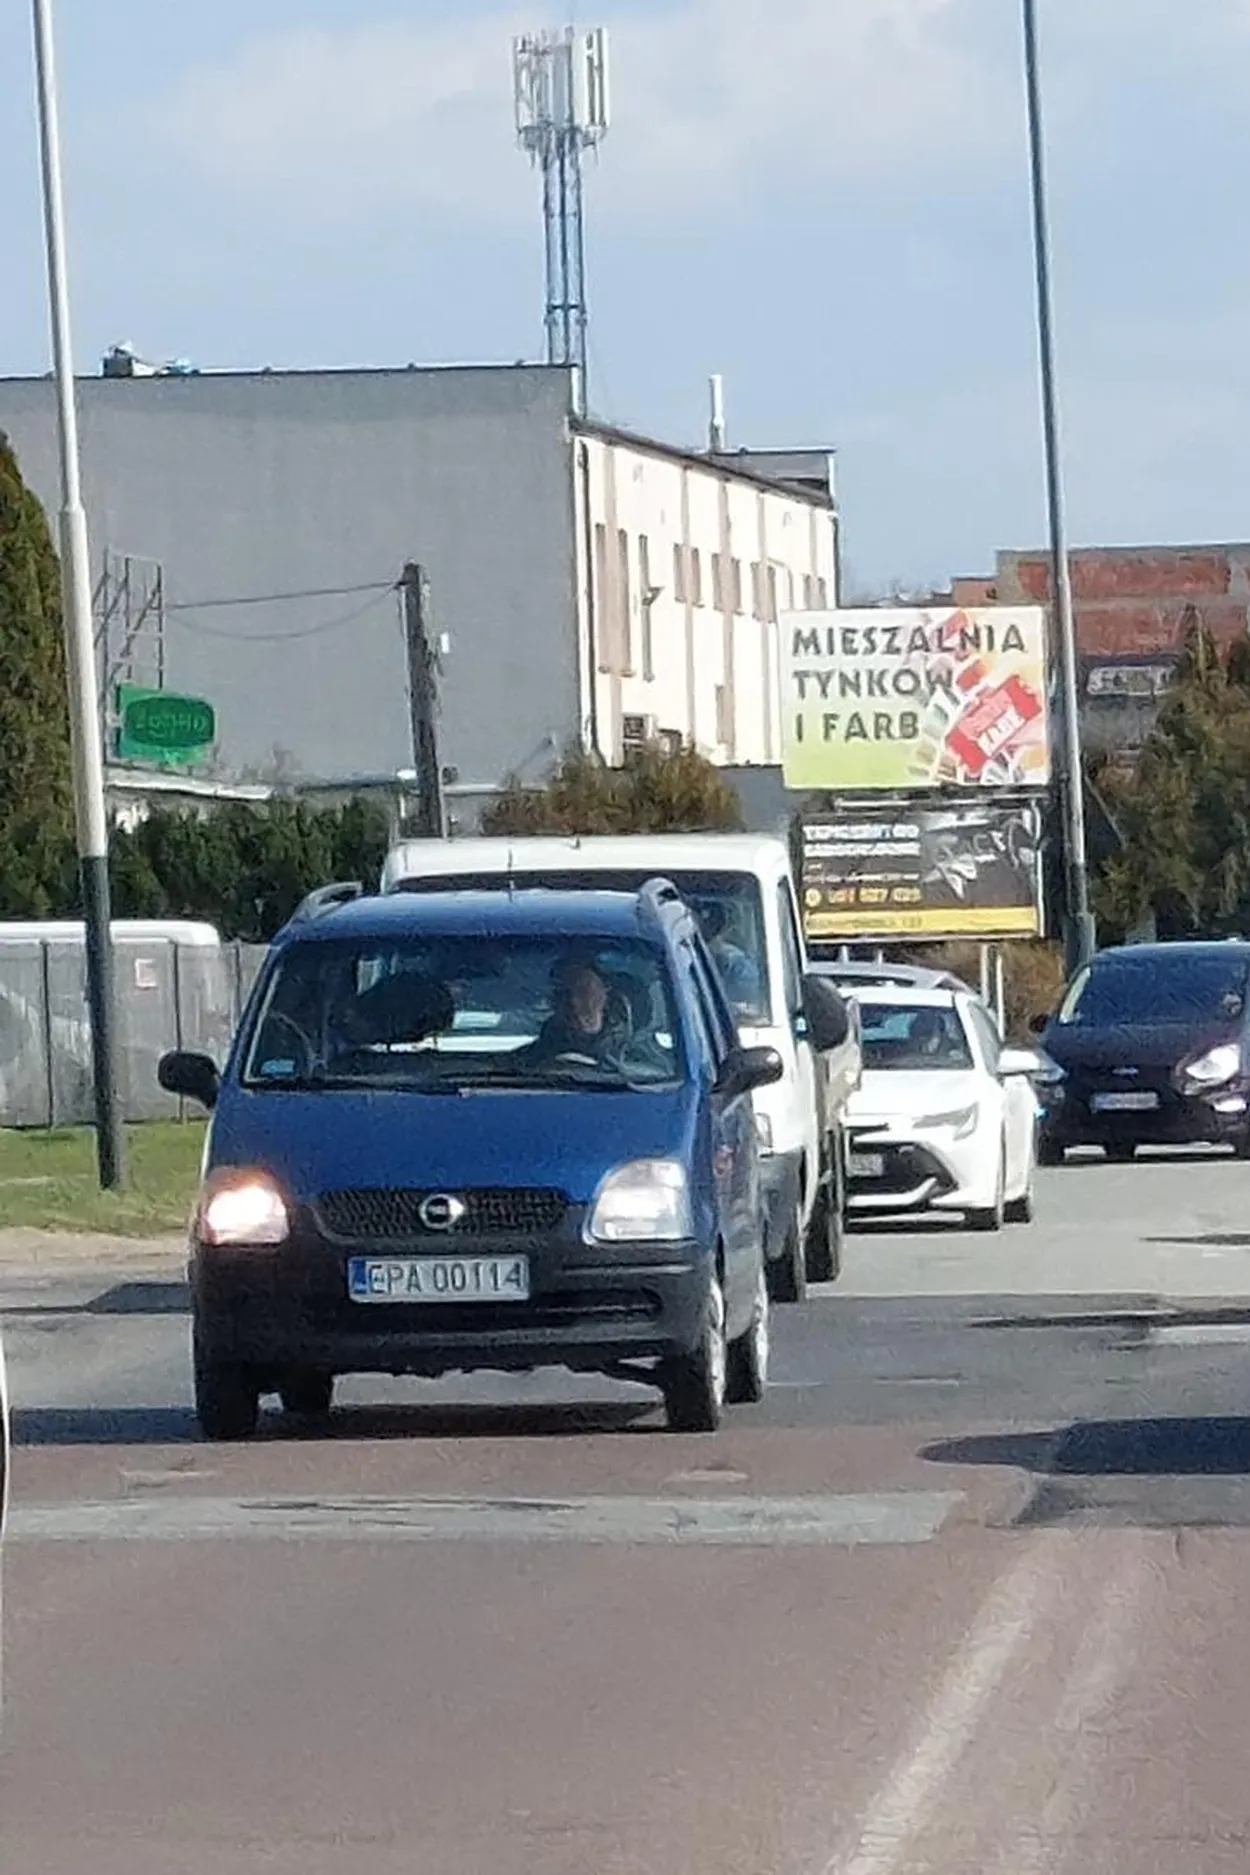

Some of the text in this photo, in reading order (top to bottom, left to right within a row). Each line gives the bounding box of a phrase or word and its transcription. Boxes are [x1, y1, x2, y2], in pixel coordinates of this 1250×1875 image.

[792, 624, 1026, 657] MIESZALNIA
[796, 710, 920, 742] I FARB
[368, 1261, 525, 1294] EPA 00114
